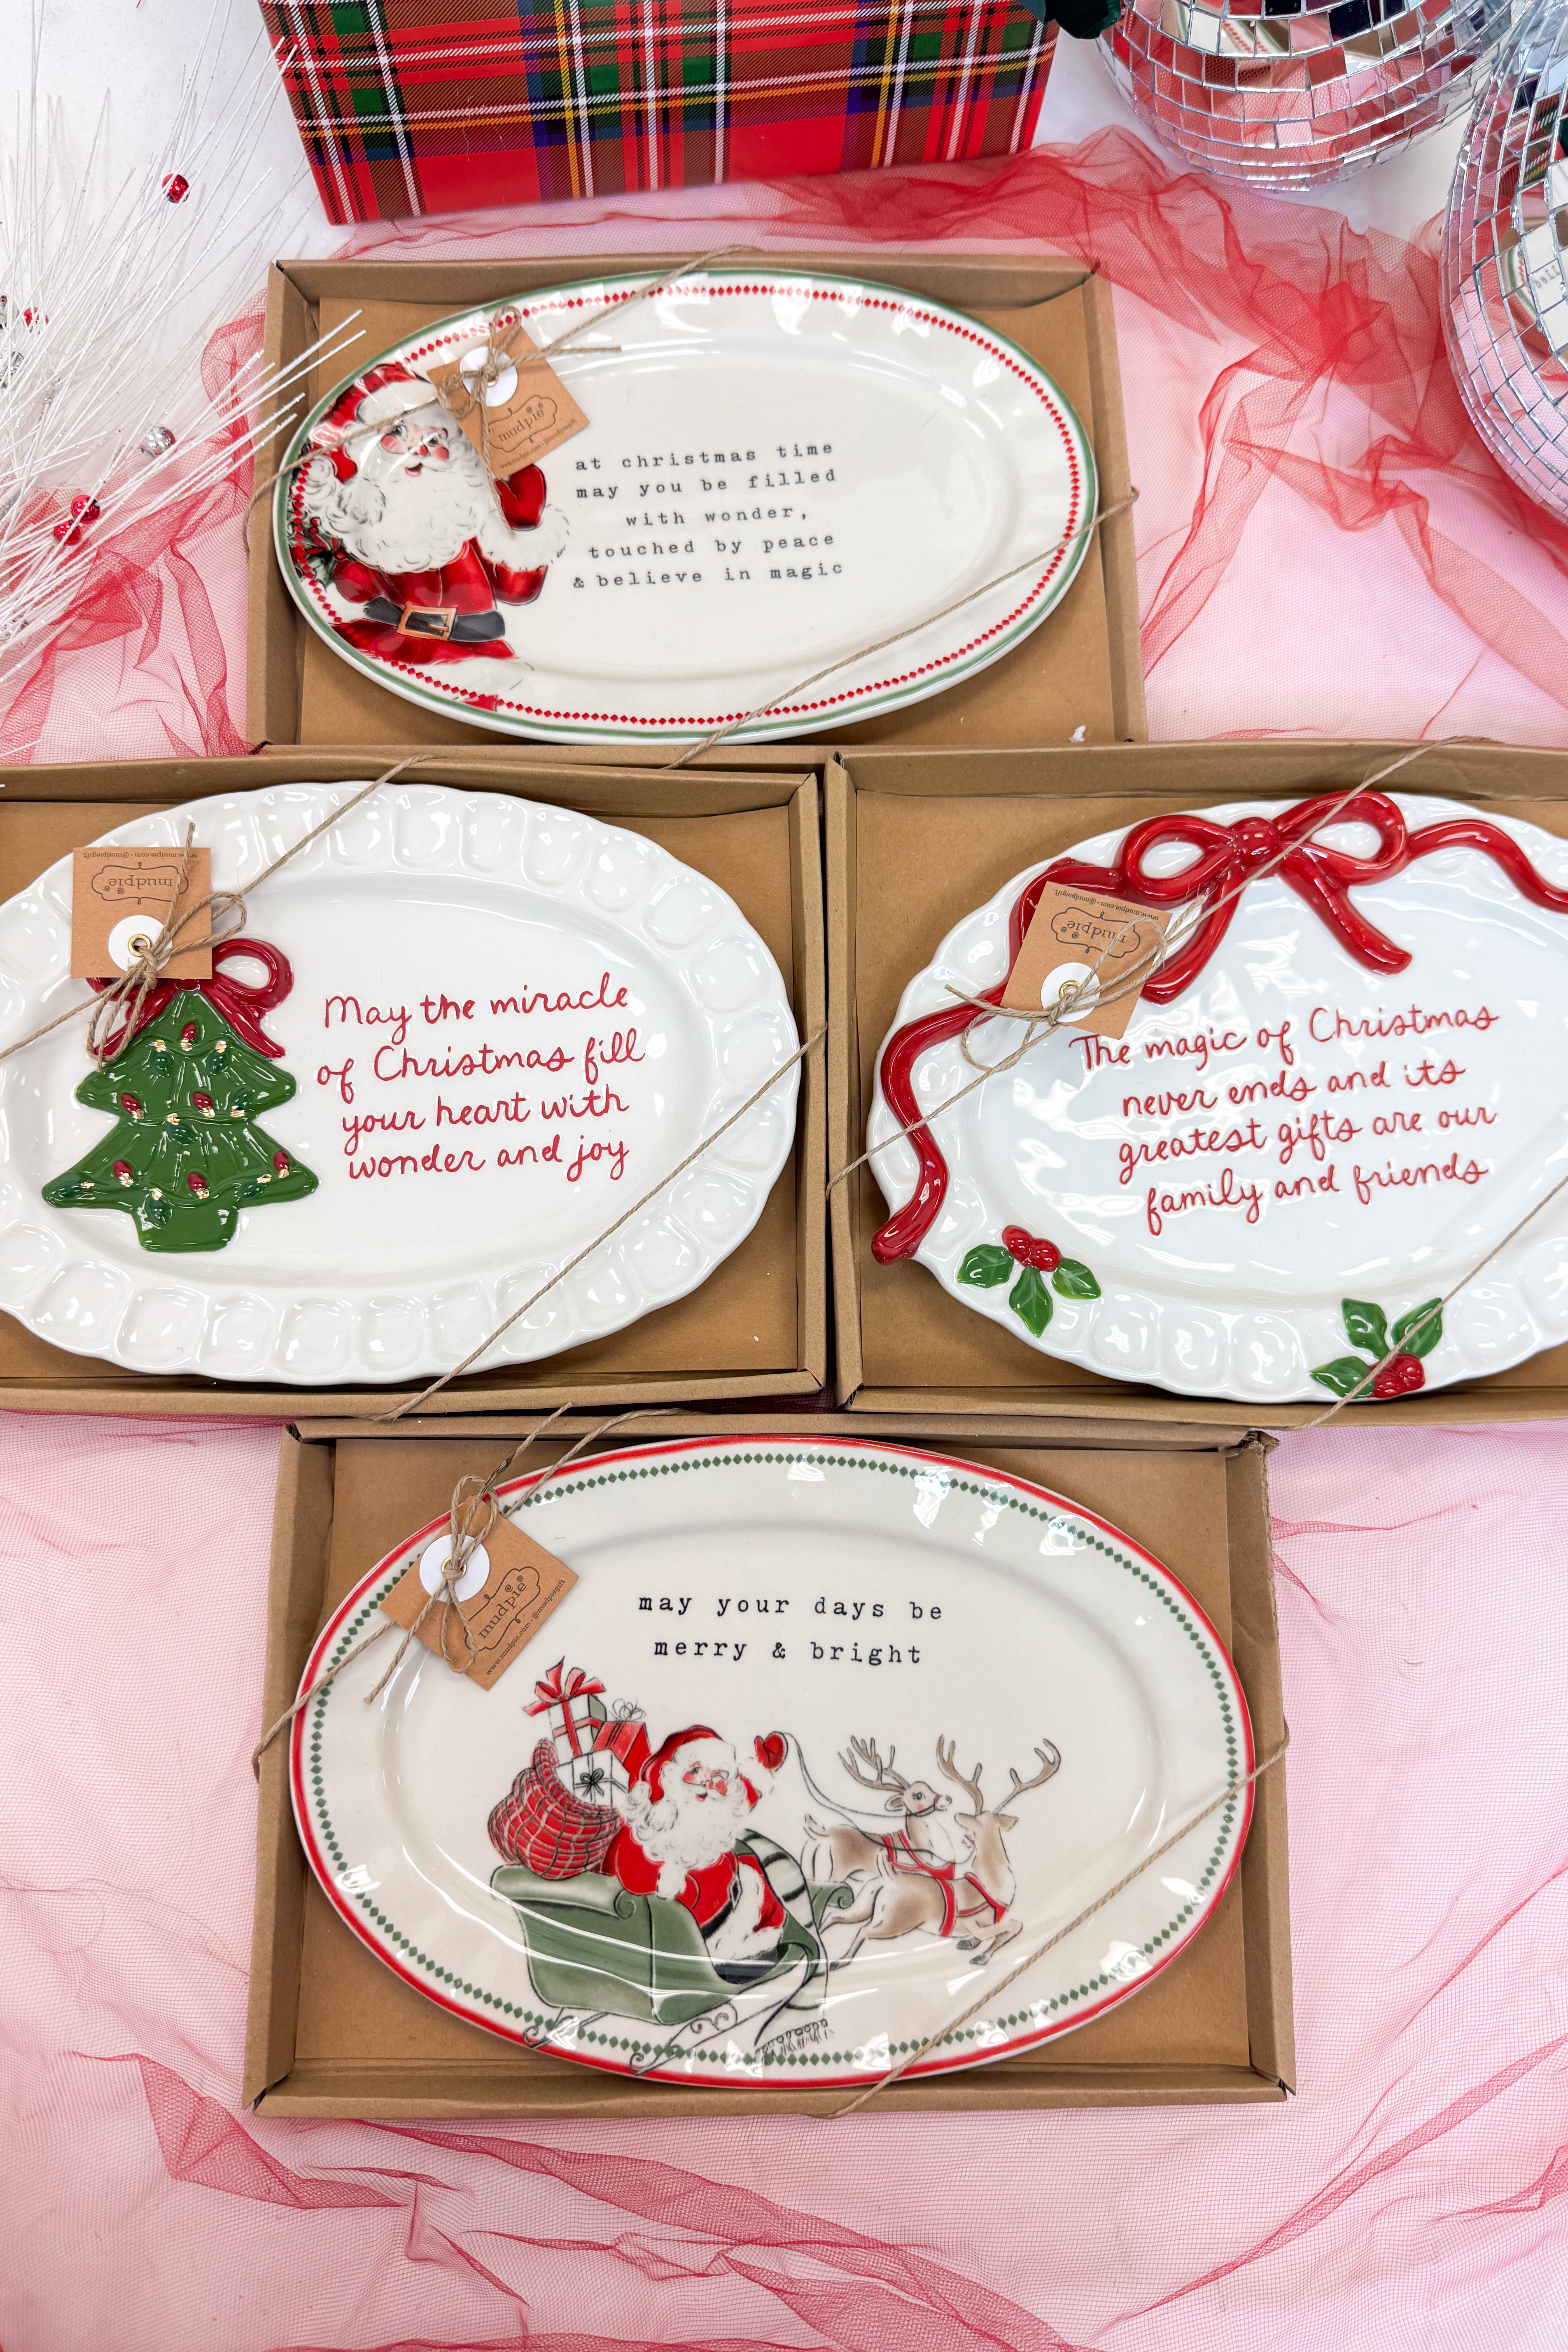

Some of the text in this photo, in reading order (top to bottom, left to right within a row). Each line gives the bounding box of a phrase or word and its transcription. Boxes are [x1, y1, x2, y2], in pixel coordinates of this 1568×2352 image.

[498, 407, 545, 442] mudpie
[499, 418, 578, 469] www.mudpie.com @mudpiegift
[576, 443, 833, 470] at christmas time
[576, 469, 835, 499] may you be filled
[626, 507, 807, 527] with wonder,
[589, 534, 834, 559] touched by peace
[573, 562, 842, 588] & believe in magic
[108, 875, 174, 894] mudpie
[1054, 889, 1097, 905] @mudpiegift
[324, 972, 628, 1045] May the miracle
[1068, 1004, 1500, 1071] The magic of Christmas
[317, 1027, 646, 1104] of Christmas fill
[1122, 1059, 1466, 1117] never ends and its
[342, 1084, 630, 1156] your heart with
[349, 1134, 630, 1183] wonder and joy
[1118, 1106, 1497, 1185] greatest gifts are our
[1146, 1153, 1489, 1237] family and friends
[478, 1582, 527, 1640] mudpie
[486, 1579, 565, 1675] www.mudpie.com @mudpiegift
[639, 1596, 942, 1620] may your days be
[653, 1641, 921, 1666] merry & bright
